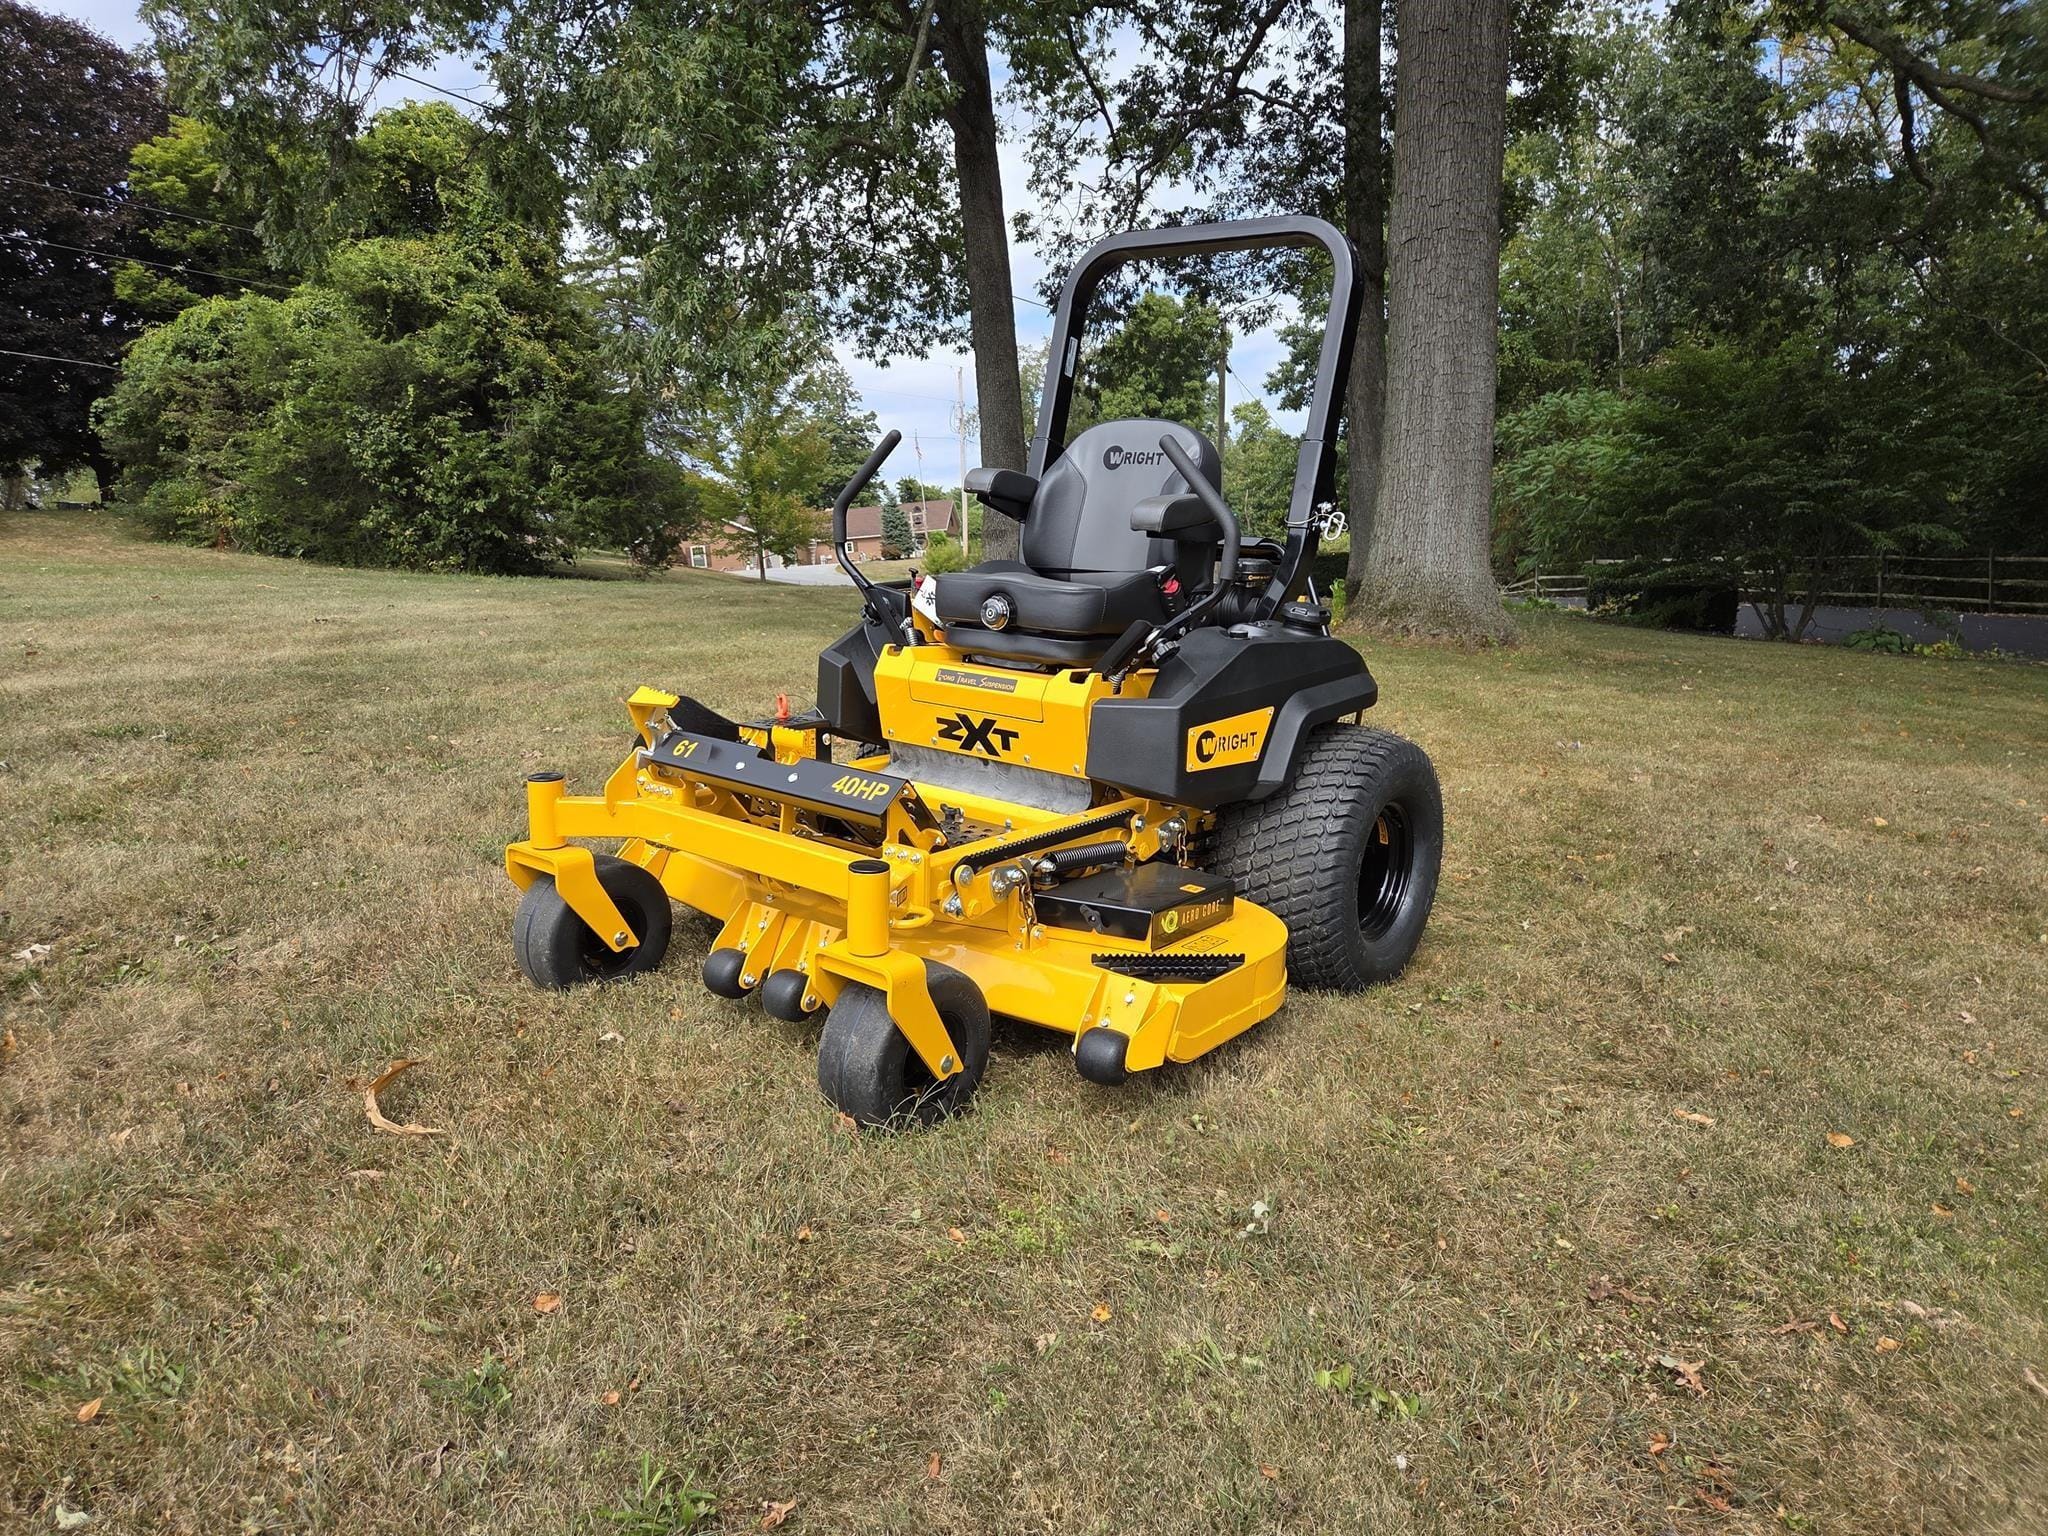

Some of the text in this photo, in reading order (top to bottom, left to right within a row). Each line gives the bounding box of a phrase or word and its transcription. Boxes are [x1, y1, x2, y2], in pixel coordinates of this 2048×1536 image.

[1103, 445, 1164, 470] WRIGHT
[672, 739, 699, 758] 61
[1196, 730, 1257, 763] WRIGHT
[831, 775, 890, 801] 40HP
[1181, 907, 1200, 926] AERO
